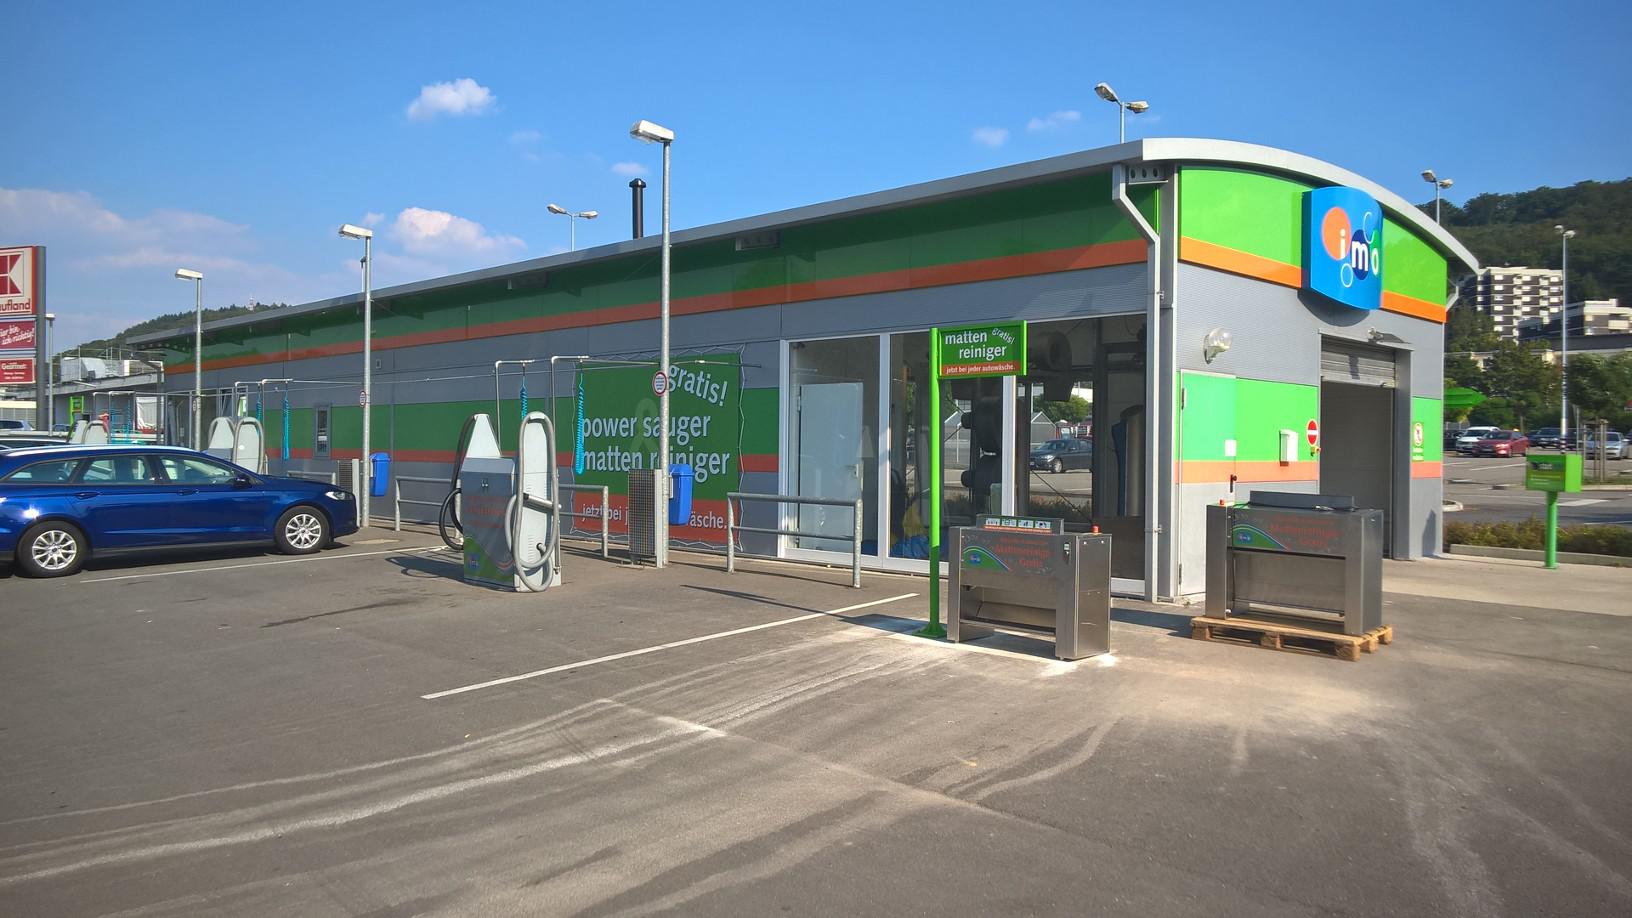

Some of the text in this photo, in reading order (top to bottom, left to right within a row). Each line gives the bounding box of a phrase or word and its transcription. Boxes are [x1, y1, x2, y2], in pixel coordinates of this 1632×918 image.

[1339, 228, 1379, 276] imo
[0, 298, 31, 311] ufland
[945, 328, 1015, 345] matten gratis!
[959, 344, 1007, 361] reiniger
[668, 365, 728, 407] gratis!
[584, 445, 730, 483] matten riniger
